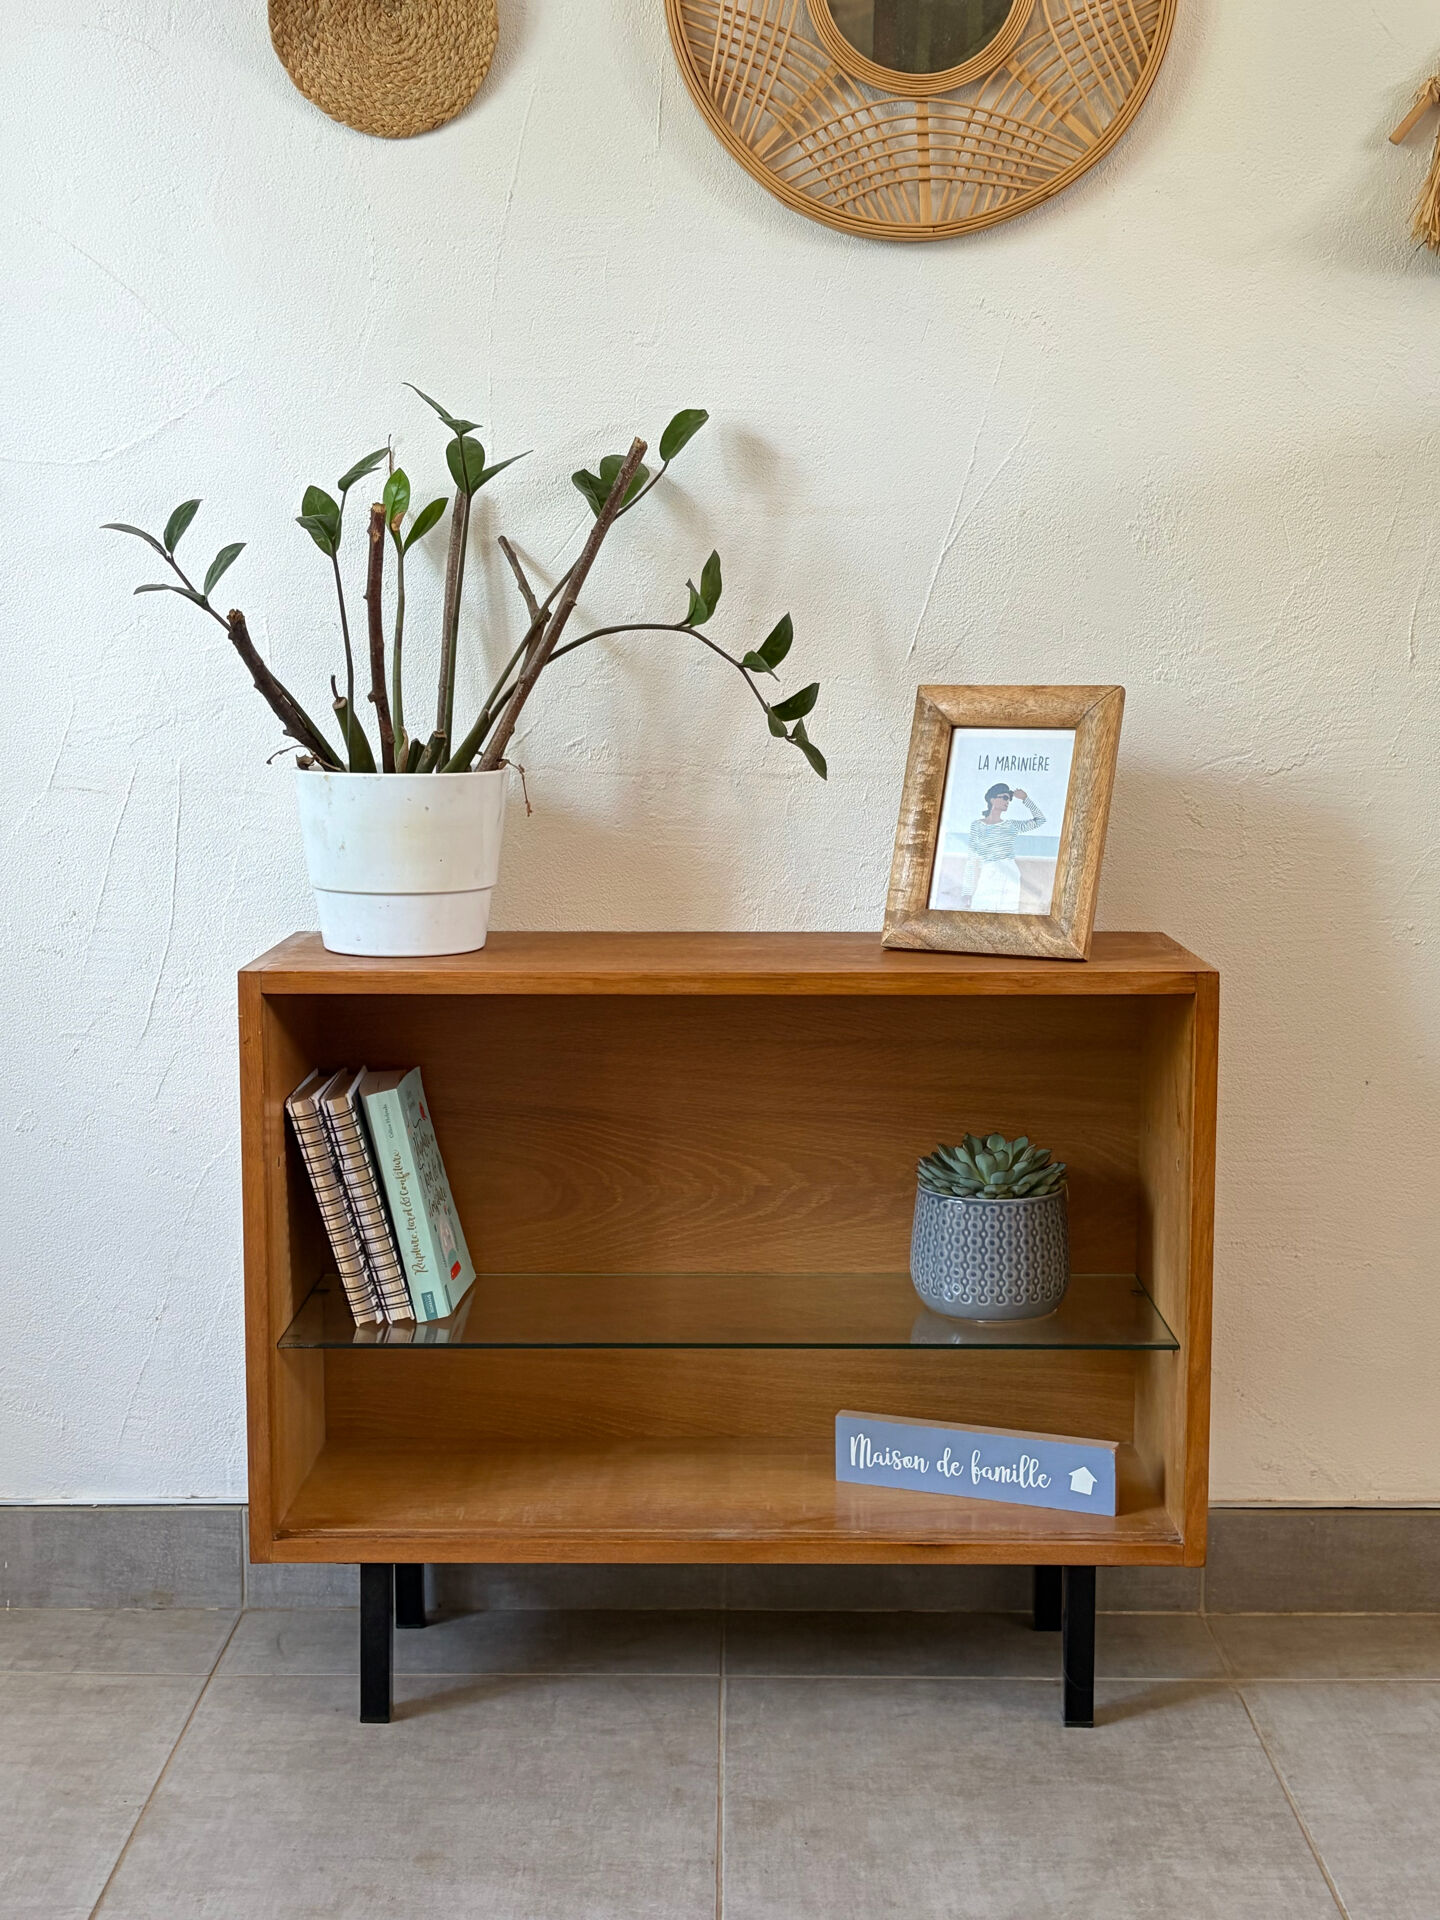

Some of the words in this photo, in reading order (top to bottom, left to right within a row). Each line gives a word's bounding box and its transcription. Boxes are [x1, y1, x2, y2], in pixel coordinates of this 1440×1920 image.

[978, 754, 990, 771] LA
[995, 753, 1050, 772] MARINIÈRE
[850, 1433, 930, 1474] Maison
[936, 1447, 964, 1478] de
[970, 1449, 1052, 1489] famille
